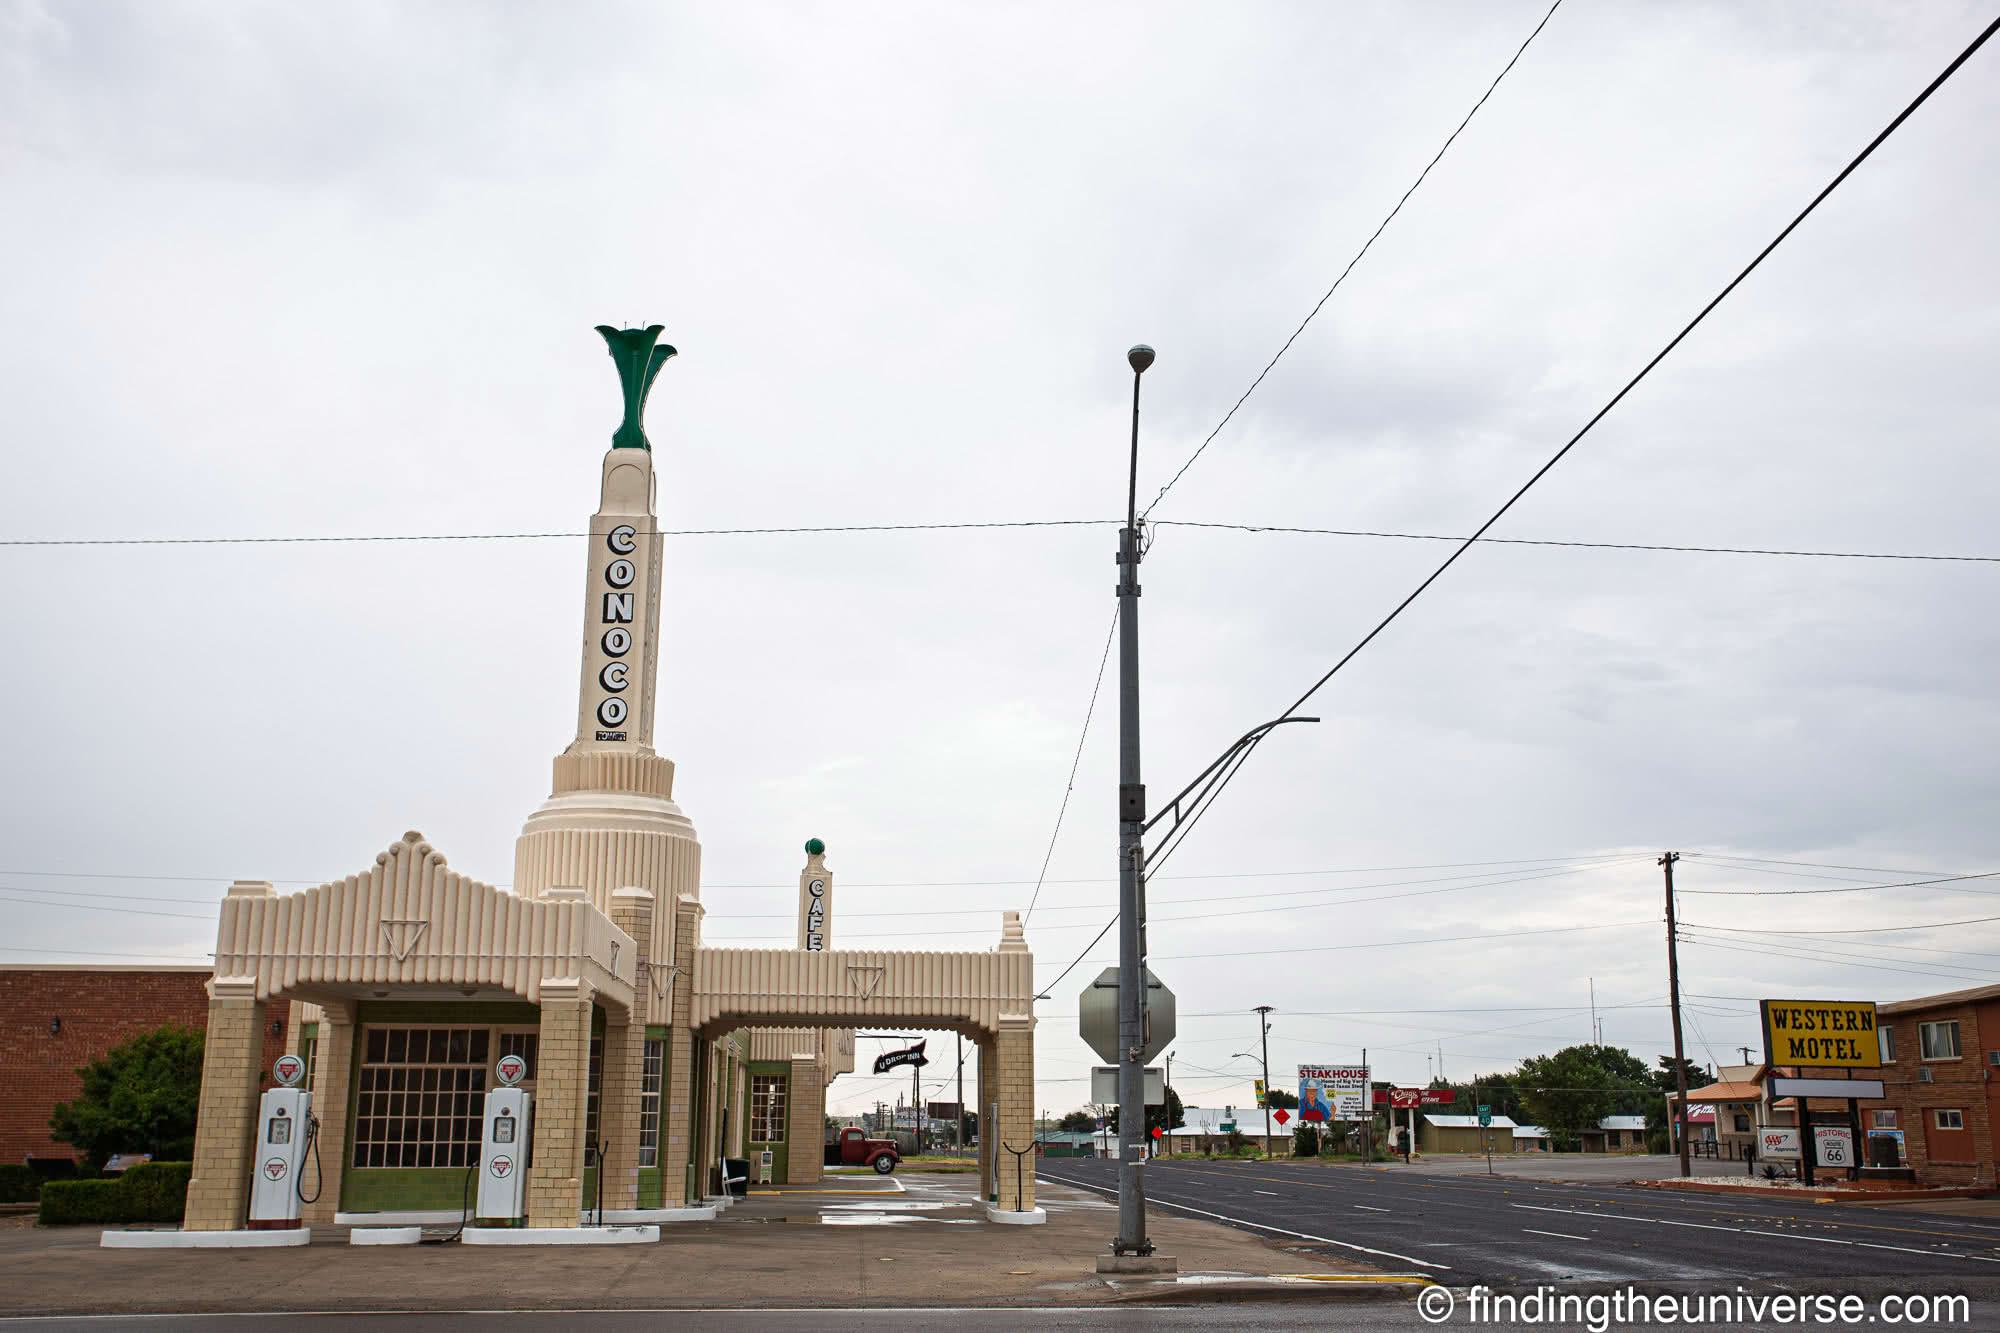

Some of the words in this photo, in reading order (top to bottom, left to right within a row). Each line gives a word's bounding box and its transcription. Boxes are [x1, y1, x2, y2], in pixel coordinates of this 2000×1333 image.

[597, 525, 637, 728] CONOCO
[807, 879, 824, 951] CAFE
[1771, 1007, 1873, 1031] WESTERN
[907, 1052, 920, 1060] INN
[1787, 1037, 1862, 1060] MOTEL
[1300, 1069, 1369, 1079] STEAKHOUSE
[1815, 1129, 1851, 1139] HISTORIC
[1827, 1150, 1842, 1161] 66
